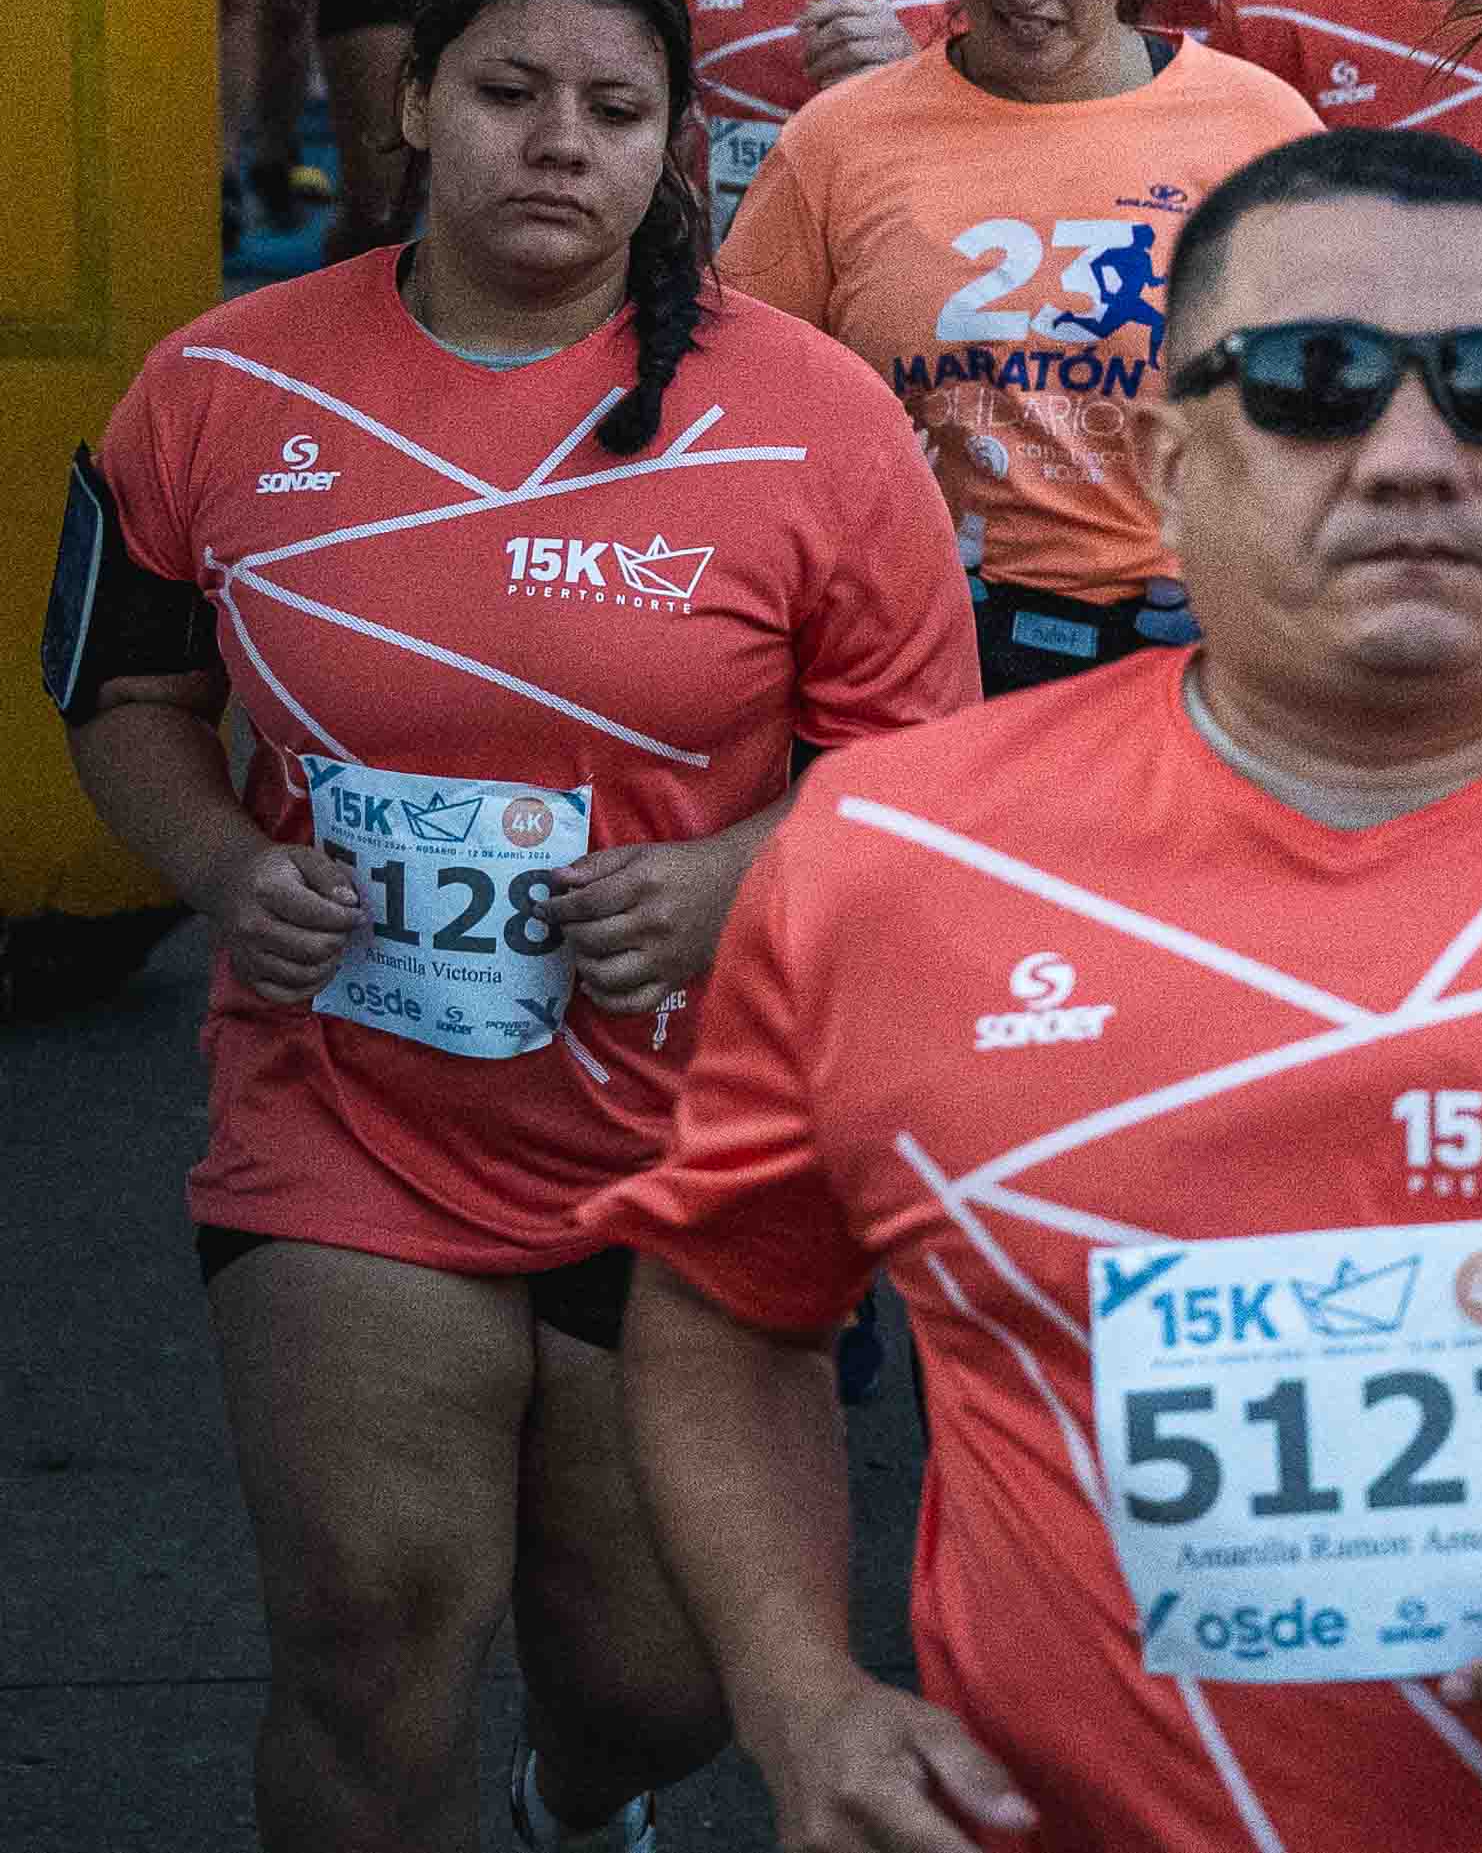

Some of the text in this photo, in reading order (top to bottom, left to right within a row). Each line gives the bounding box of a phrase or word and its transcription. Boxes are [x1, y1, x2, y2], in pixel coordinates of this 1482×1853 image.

[934, 219, 1138, 342] 23
[892, 342, 1148, 399] MARATÓN
[506, 536, 609, 587] 15K
[507, 584, 693, 615] PUERTO NORTE
[331, 787, 394, 836] 15K
[511, 813, 544, 834] 4K
[323, 838, 566, 958] 128
[365, 948, 503, 984] Amarilla Victoria
[346, 982, 423, 1023] osde
[1150, 1281, 1280, 1348] 15K
[1196, 1596, 1351, 1660] osde
